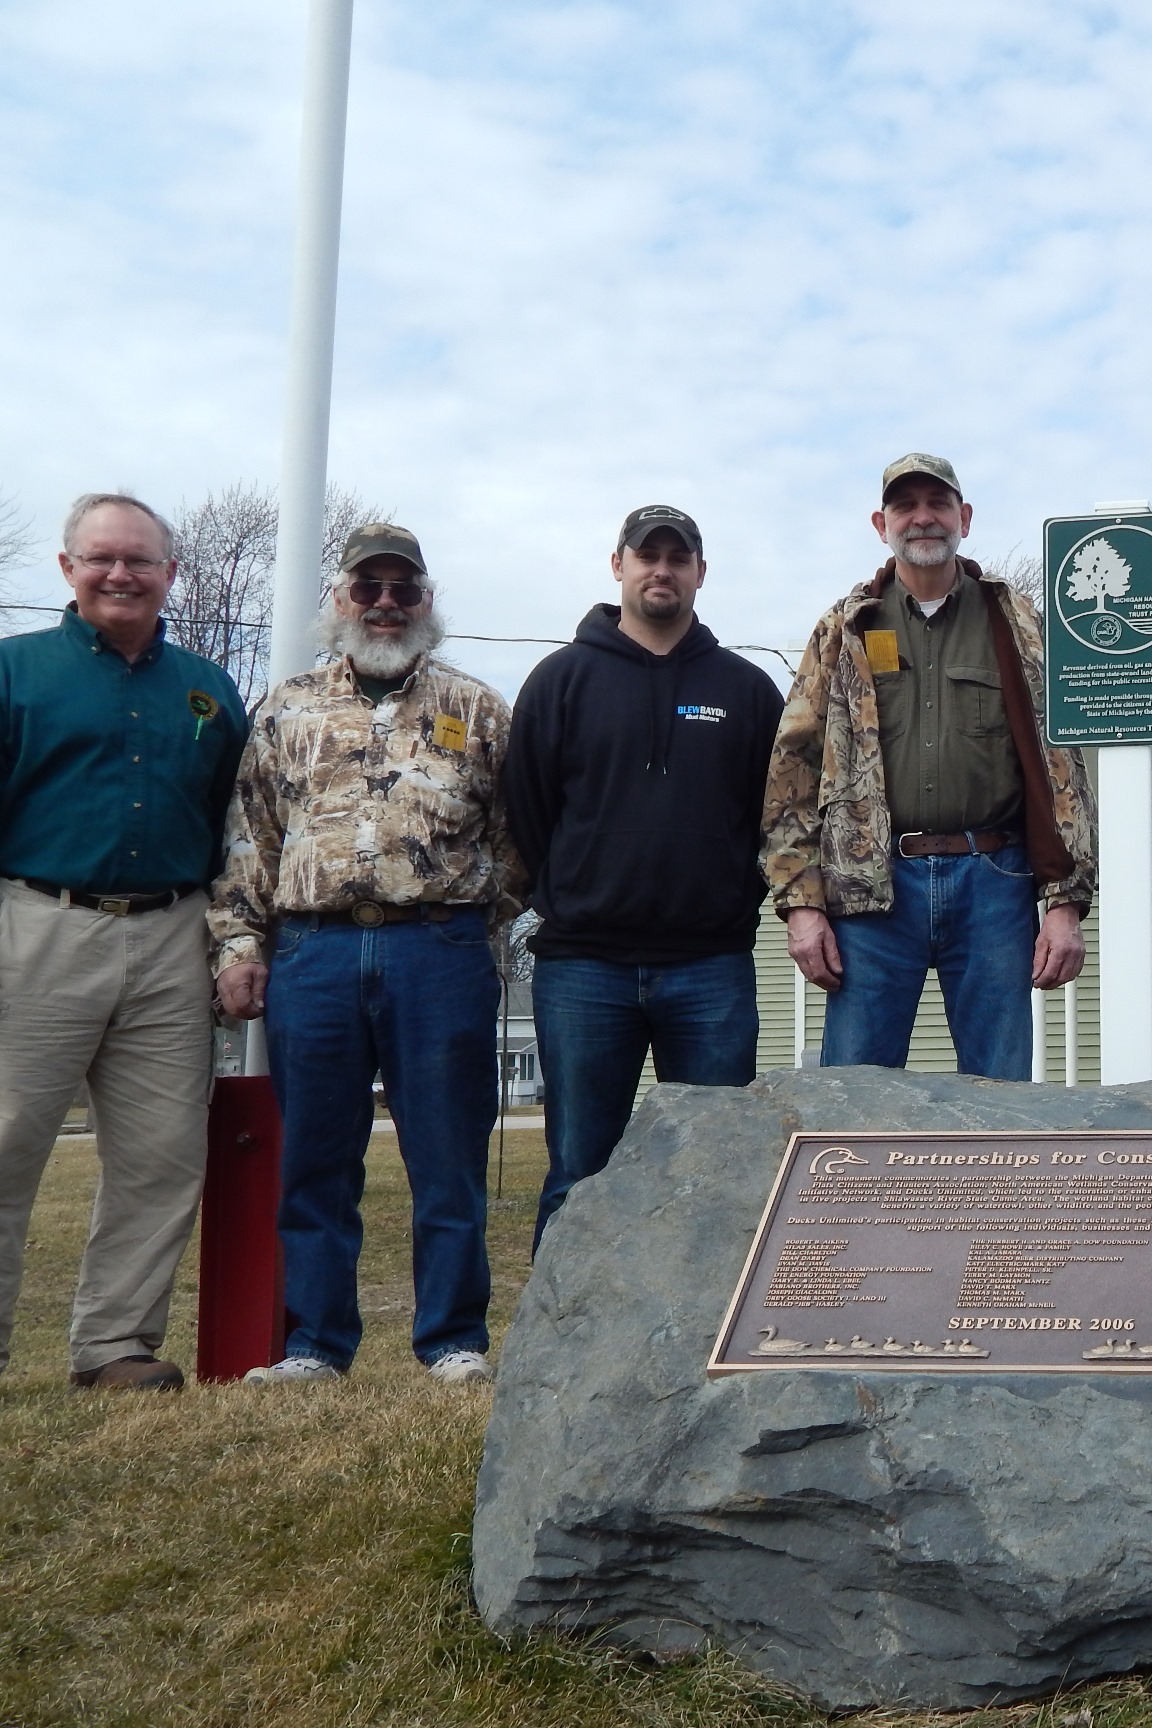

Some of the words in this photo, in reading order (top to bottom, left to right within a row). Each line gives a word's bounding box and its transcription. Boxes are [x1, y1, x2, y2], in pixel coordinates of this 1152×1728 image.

[1059, 672, 1089, 680] production
[1106, 669, 1139, 677] state-owned
[1113, 677, 1130, 685] public
[1064, 695, 1086, 703] Funding
[1110, 693, 1133, 701] possible
[1079, 702, 1104, 710] provided
[1108, 709, 1134, 717] Michigan
[1057, 727, 1087, 736] Michigan
[1114, 724, 1145, 732] Resources
[886, 1151, 1040, 1167] Partnerships
[1050, 1151, 1087, 1164] for
[874, 1216, 932, 1224] participation
[948, 1216, 979, 1225] habitat
[983, 1217, 1041, 1225] conservation
[1044, 1216, 1081, 1225] projects
[1085, 1217, 1106, 1225] such
[948, 1317, 1081, 1329] SEPTEMBER
[1089, 1318, 1134, 1330] 2006
